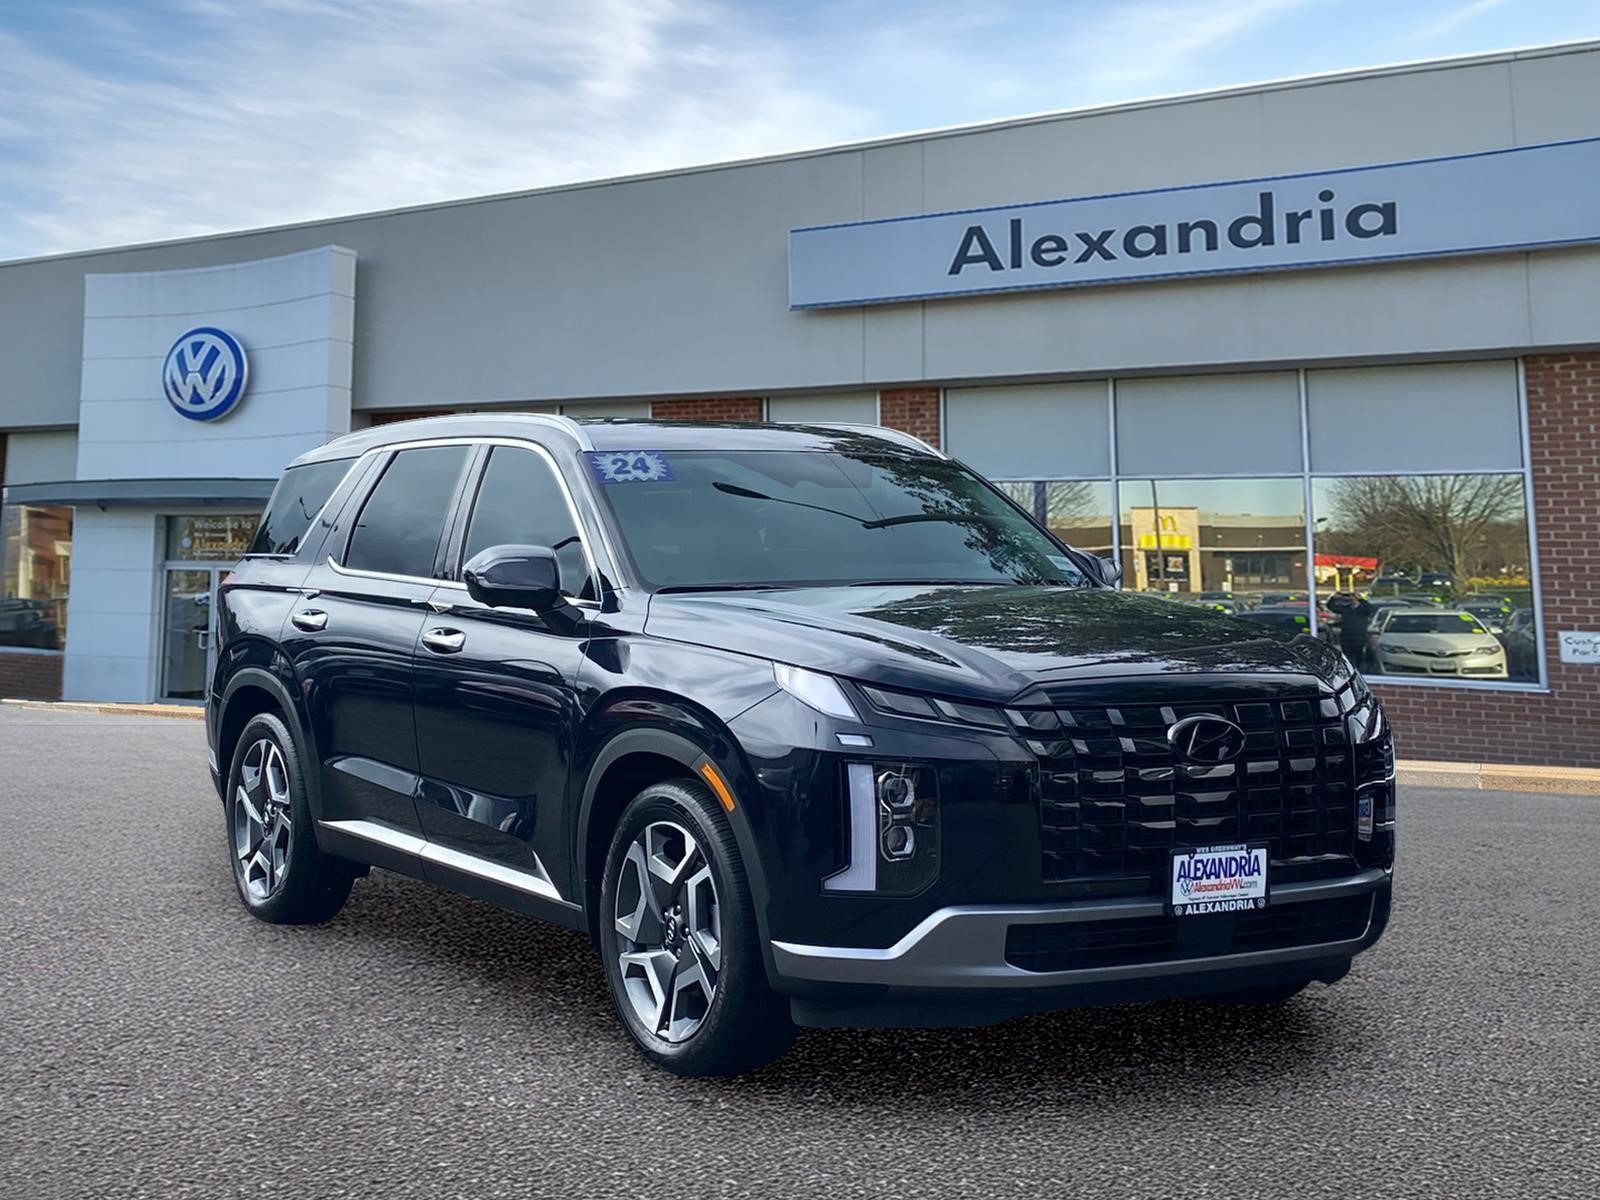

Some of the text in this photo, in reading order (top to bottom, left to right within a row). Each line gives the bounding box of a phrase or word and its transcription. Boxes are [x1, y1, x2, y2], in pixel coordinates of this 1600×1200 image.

[948, 190, 1398, 276] Alexandria
[165, 331, 238, 413] VW
[611, 457, 651, 475] 24
[1176, 854, 1262, 882] ALEXANDRIA
[1185, 899, 1255, 915] ALEXANDRIA
